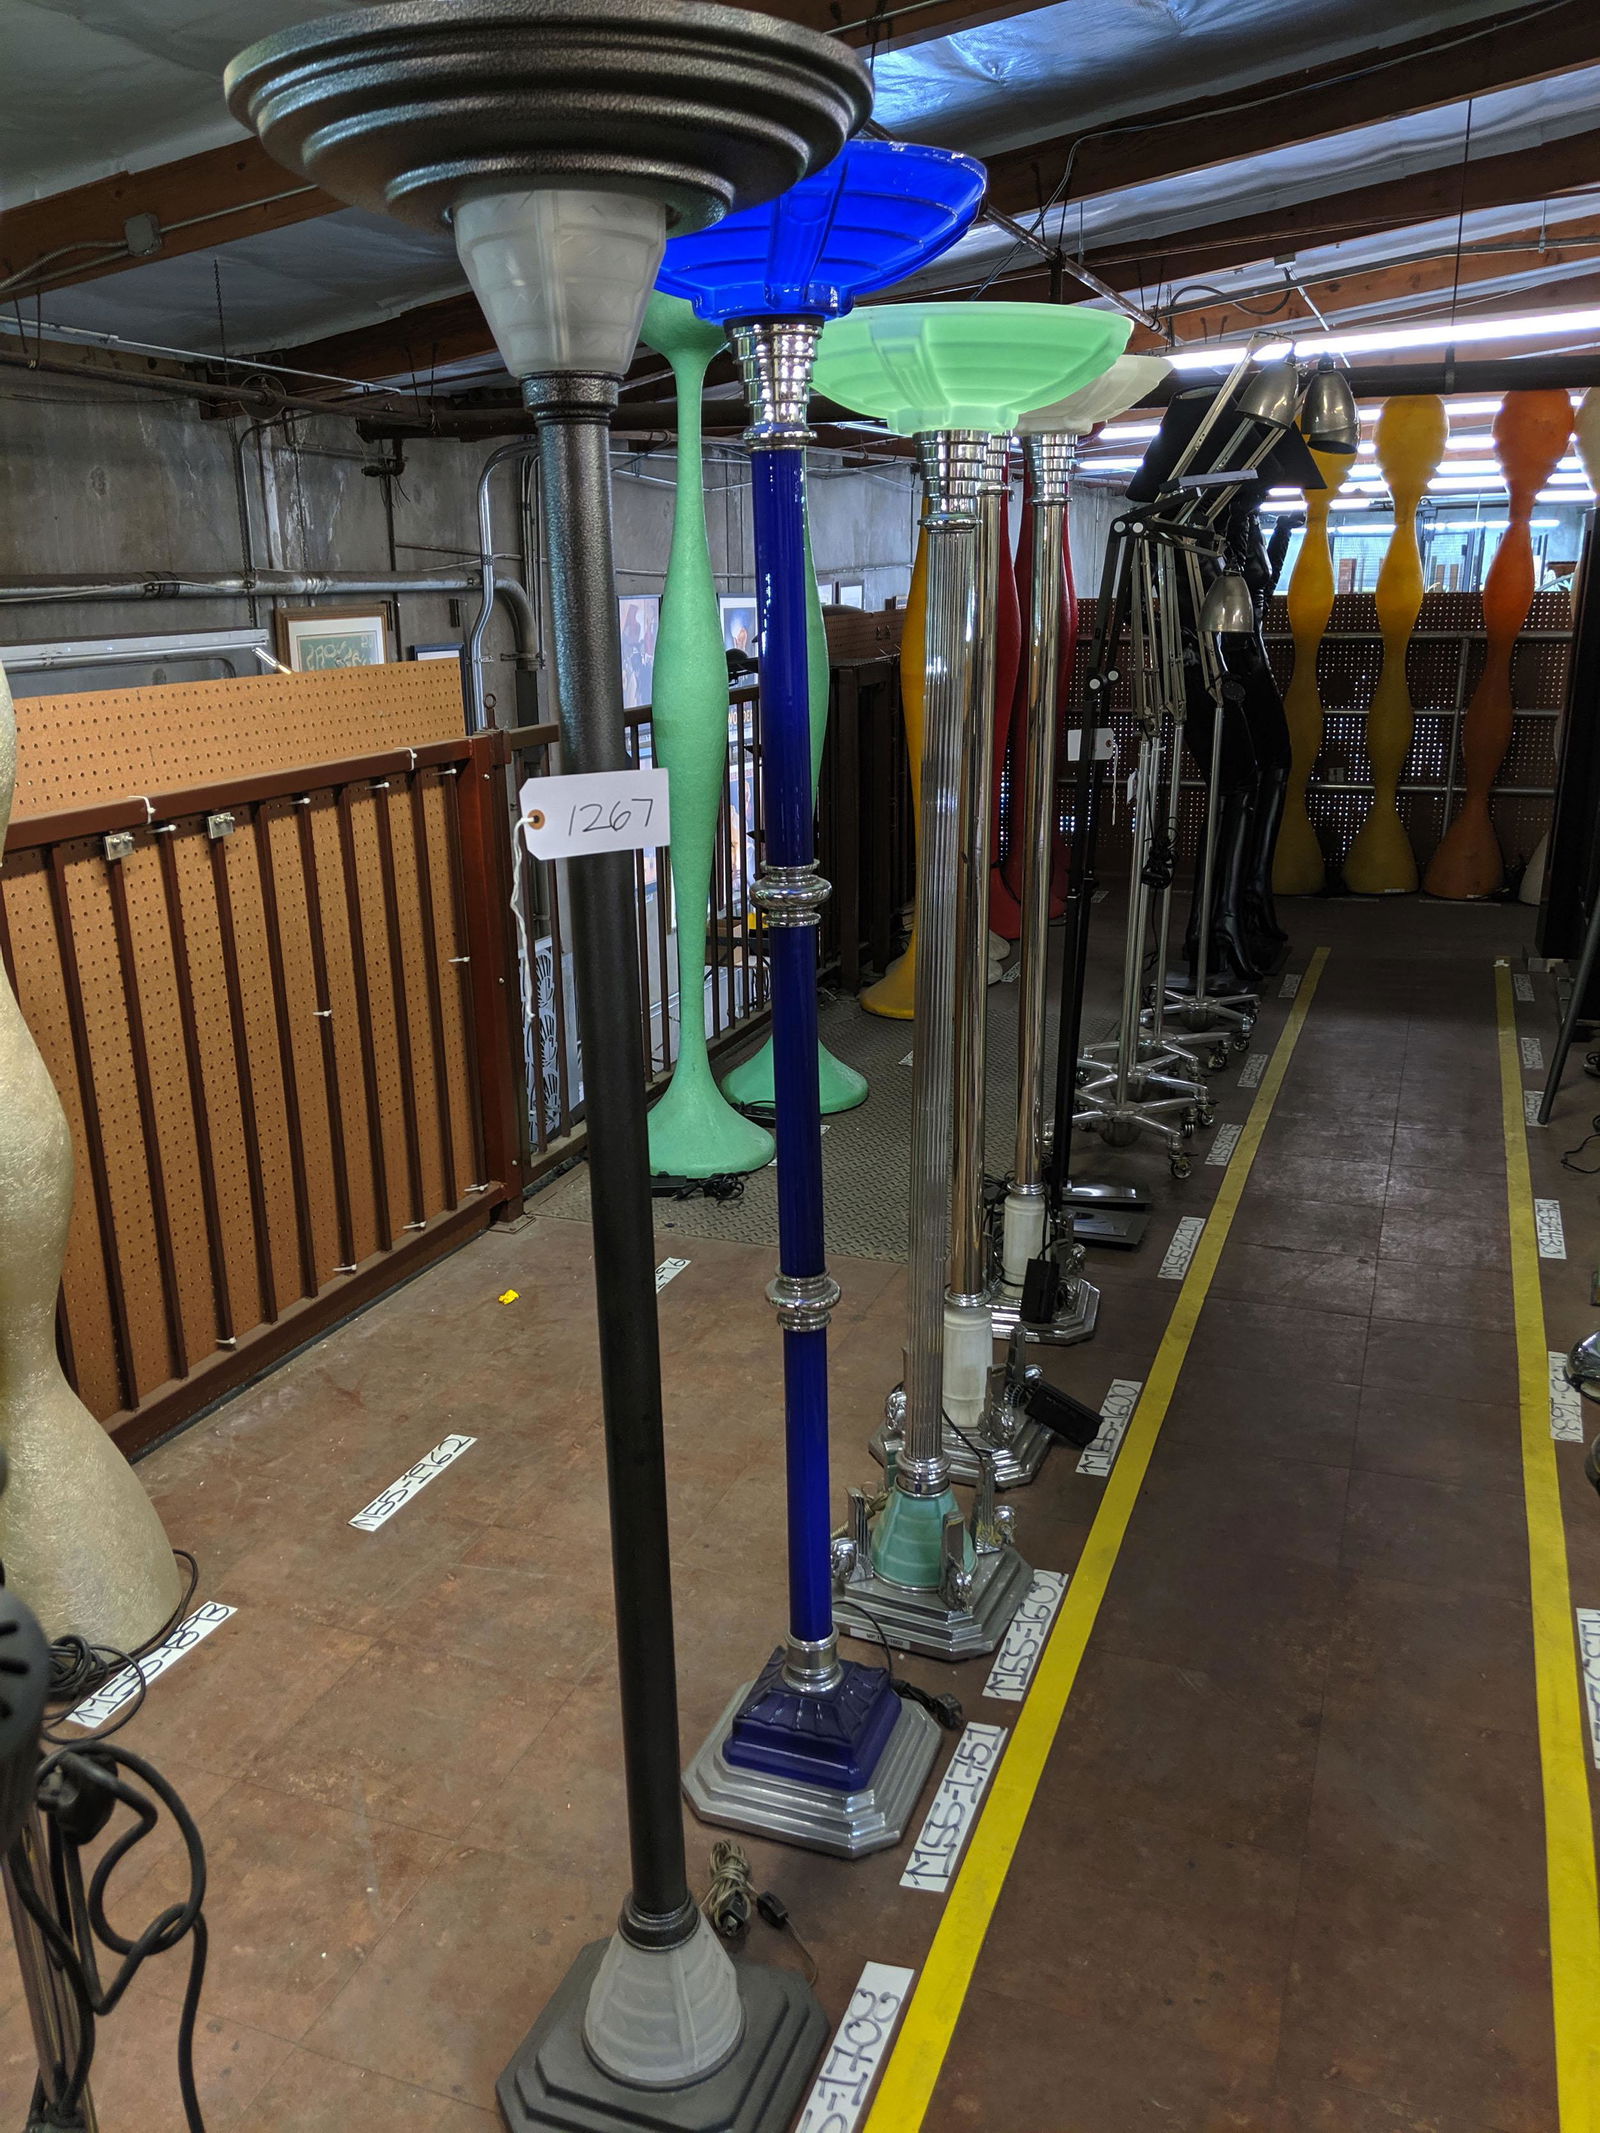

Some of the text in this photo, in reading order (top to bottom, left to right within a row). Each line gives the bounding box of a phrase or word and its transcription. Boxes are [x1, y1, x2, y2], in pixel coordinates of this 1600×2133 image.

[568, 798, 654, 836] 1267
[359, 1438, 472, 1518] 155-1962
[992, 1571, 1066, 1686] 155-1602
[914, 1727, 1006, 1874] 155-1751
